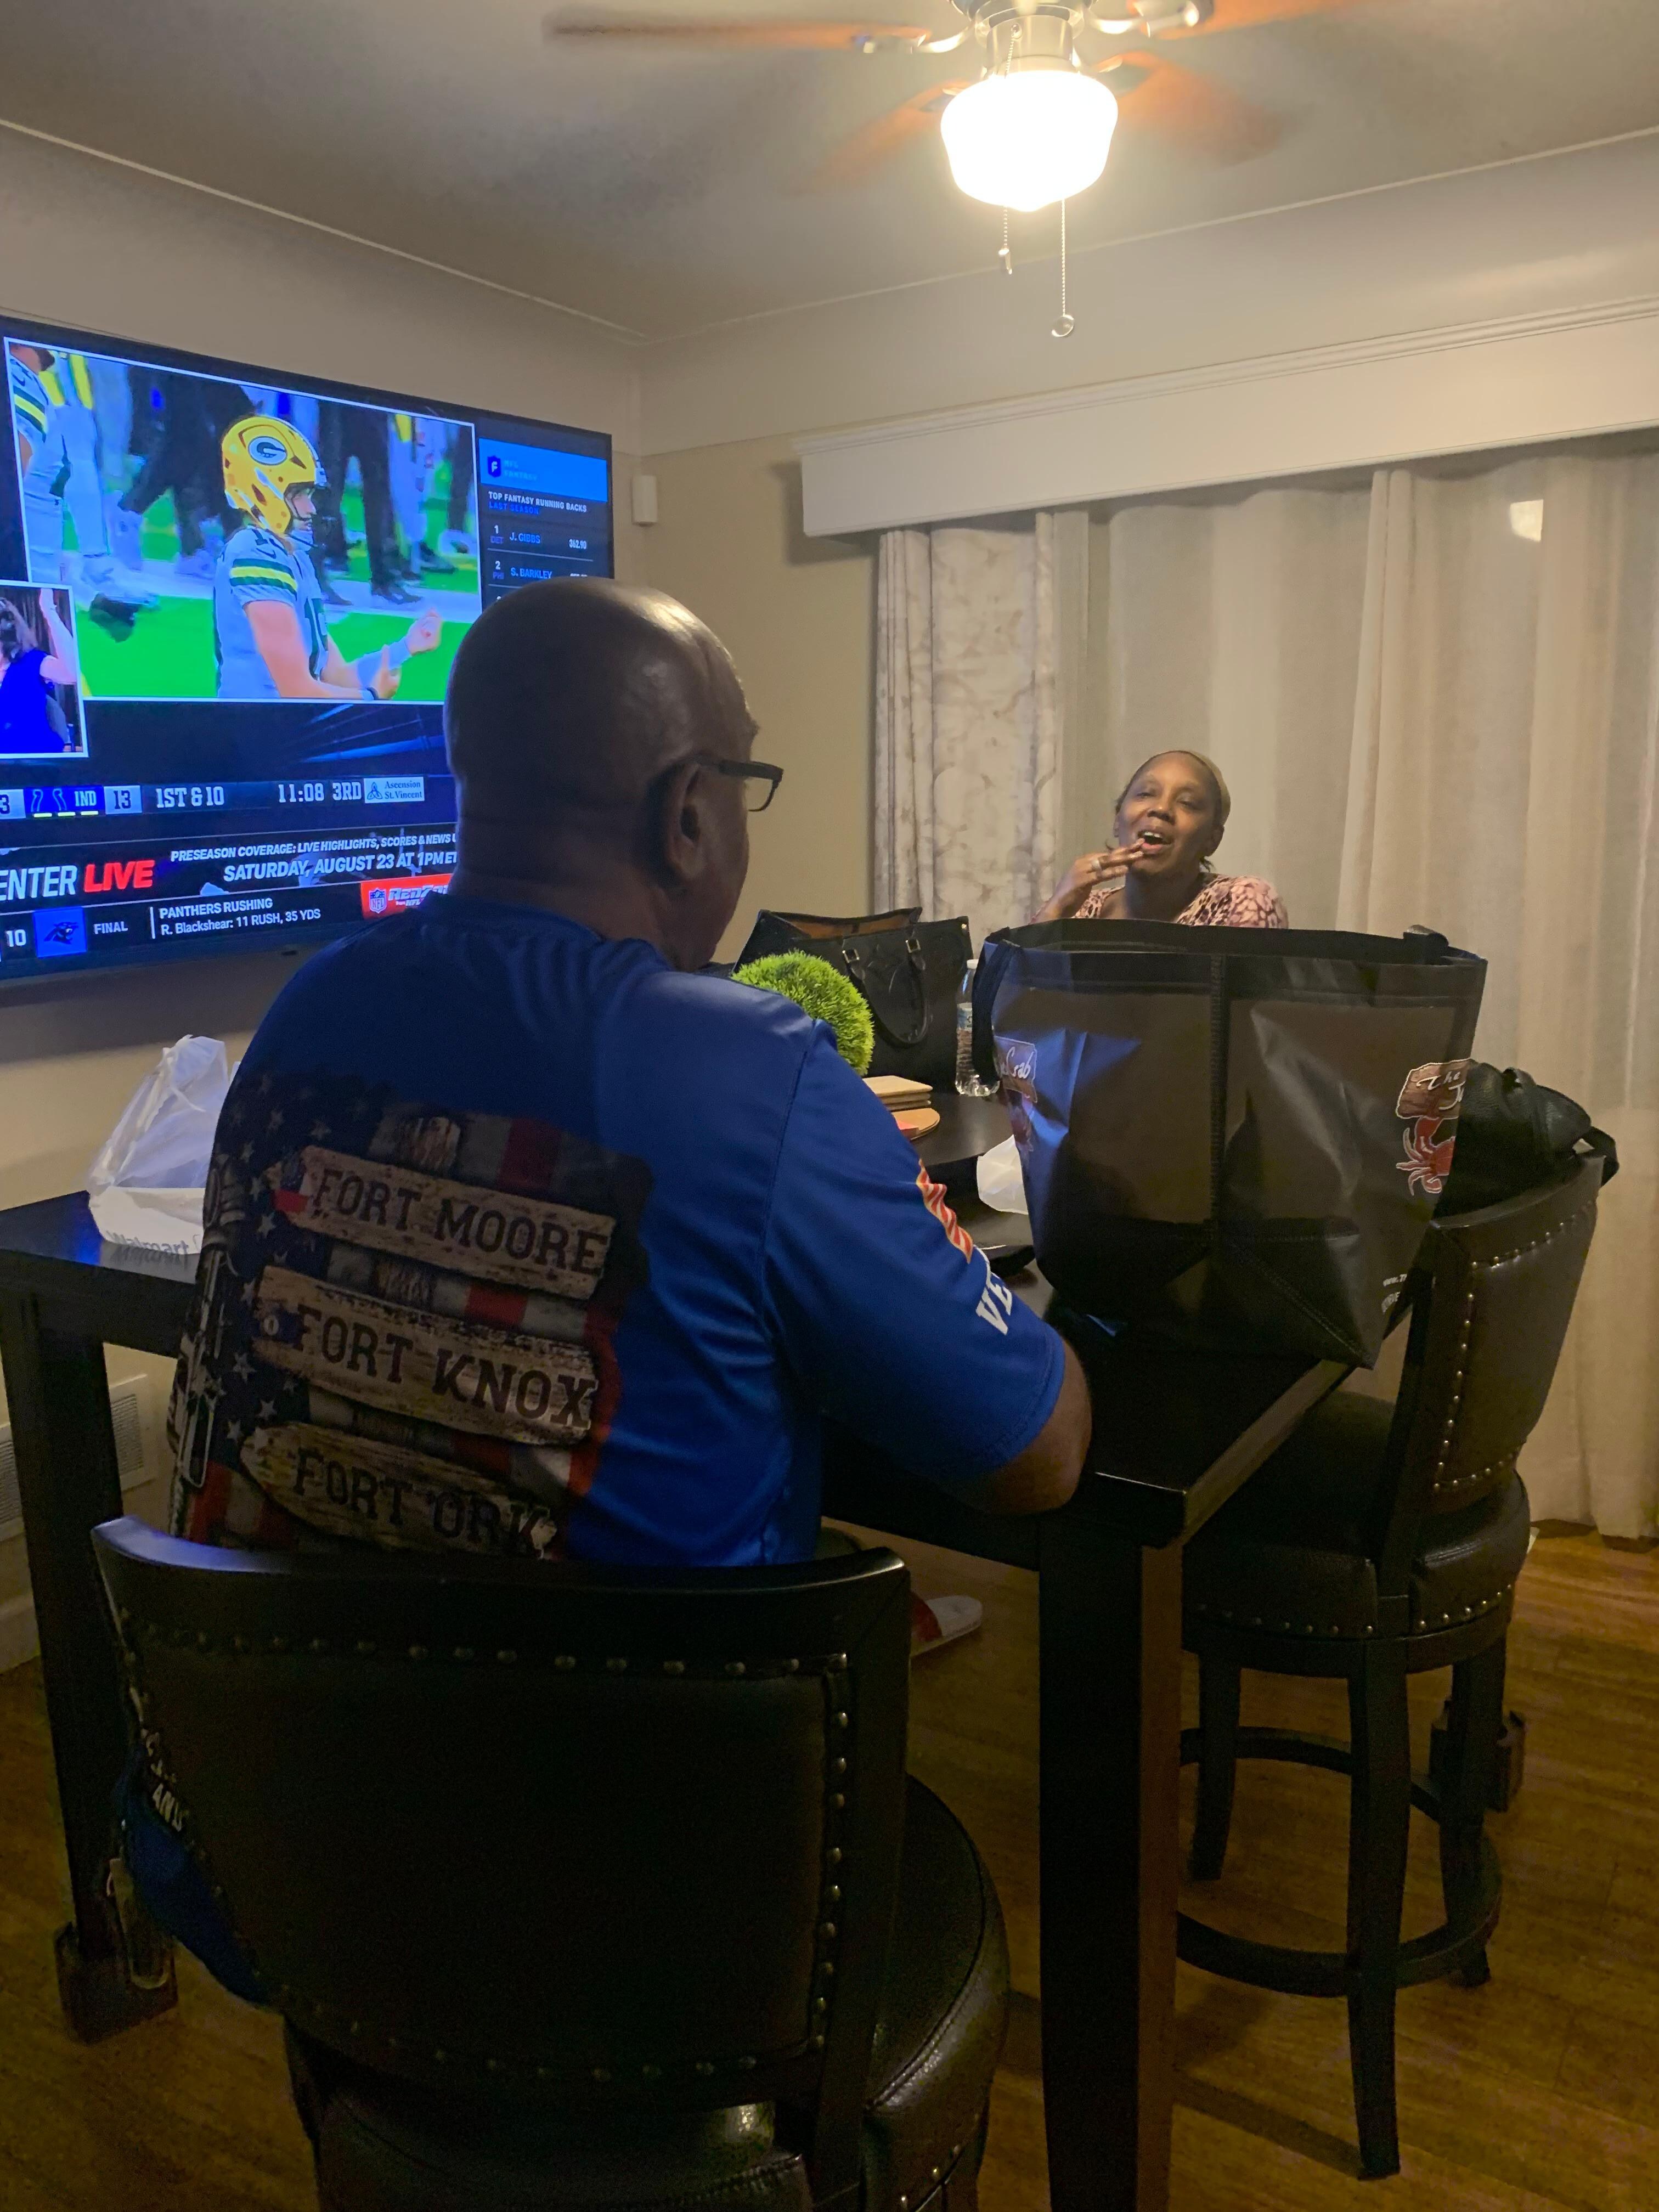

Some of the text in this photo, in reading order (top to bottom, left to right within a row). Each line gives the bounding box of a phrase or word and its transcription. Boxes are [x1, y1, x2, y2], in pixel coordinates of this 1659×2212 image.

[488, 491, 587, 512] TOP FANTASY RUNNING BACKS
[489, 501, 539, 515] LAST SEASON
[494, 524, 499, 534] 1
[509, 532, 517, 541] J.
[518, 533, 541, 544] GIBBS
[495, 560, 501, 570] 2
[510, 567, 552, 579] S. BARKLEY
[278, 781, 362, 803] 11:08 3RD
[385, 780, 421, 789] Ascension
[394, 790, 422, 799] Vincent
[74, 790, 97, 807] IND
[114, 790, 132, 810] 13
[156, 786, 225, 809] 1ST & 10
[170, 847, 238, 863] PRESEASON
[238, 843, 296, 857] COVERAGE:
[297, 840, 320, 854] LIVE
[320, 837, 380, 851] HIGHLIGHTS,
[381, 836, 417, 848] SCORES
[418, 834, 426, 845] &
[426, 833, 451, 845] NEWS
[84, 860, 155, 893] LIVE
[223, 851, 457, 882] SATURDAY, AUGUST 23 AT 1PM ET
[159, 898, 273, 919] PANTHERS RUSHING
[94, 921, 128, 935] FINAL
[161, 909, 321, 935] R. Blackshear: 11 RUSH, 35 YDS
[6, 929, 26, 947] 10
[1416, 1071, 1461, 1091] The
[312, 1167, 613, 1276] FORT MOORE
[293, 1302, 599, 1432] FORT KNOX
[293, 1447, 413, 1528] FORT
